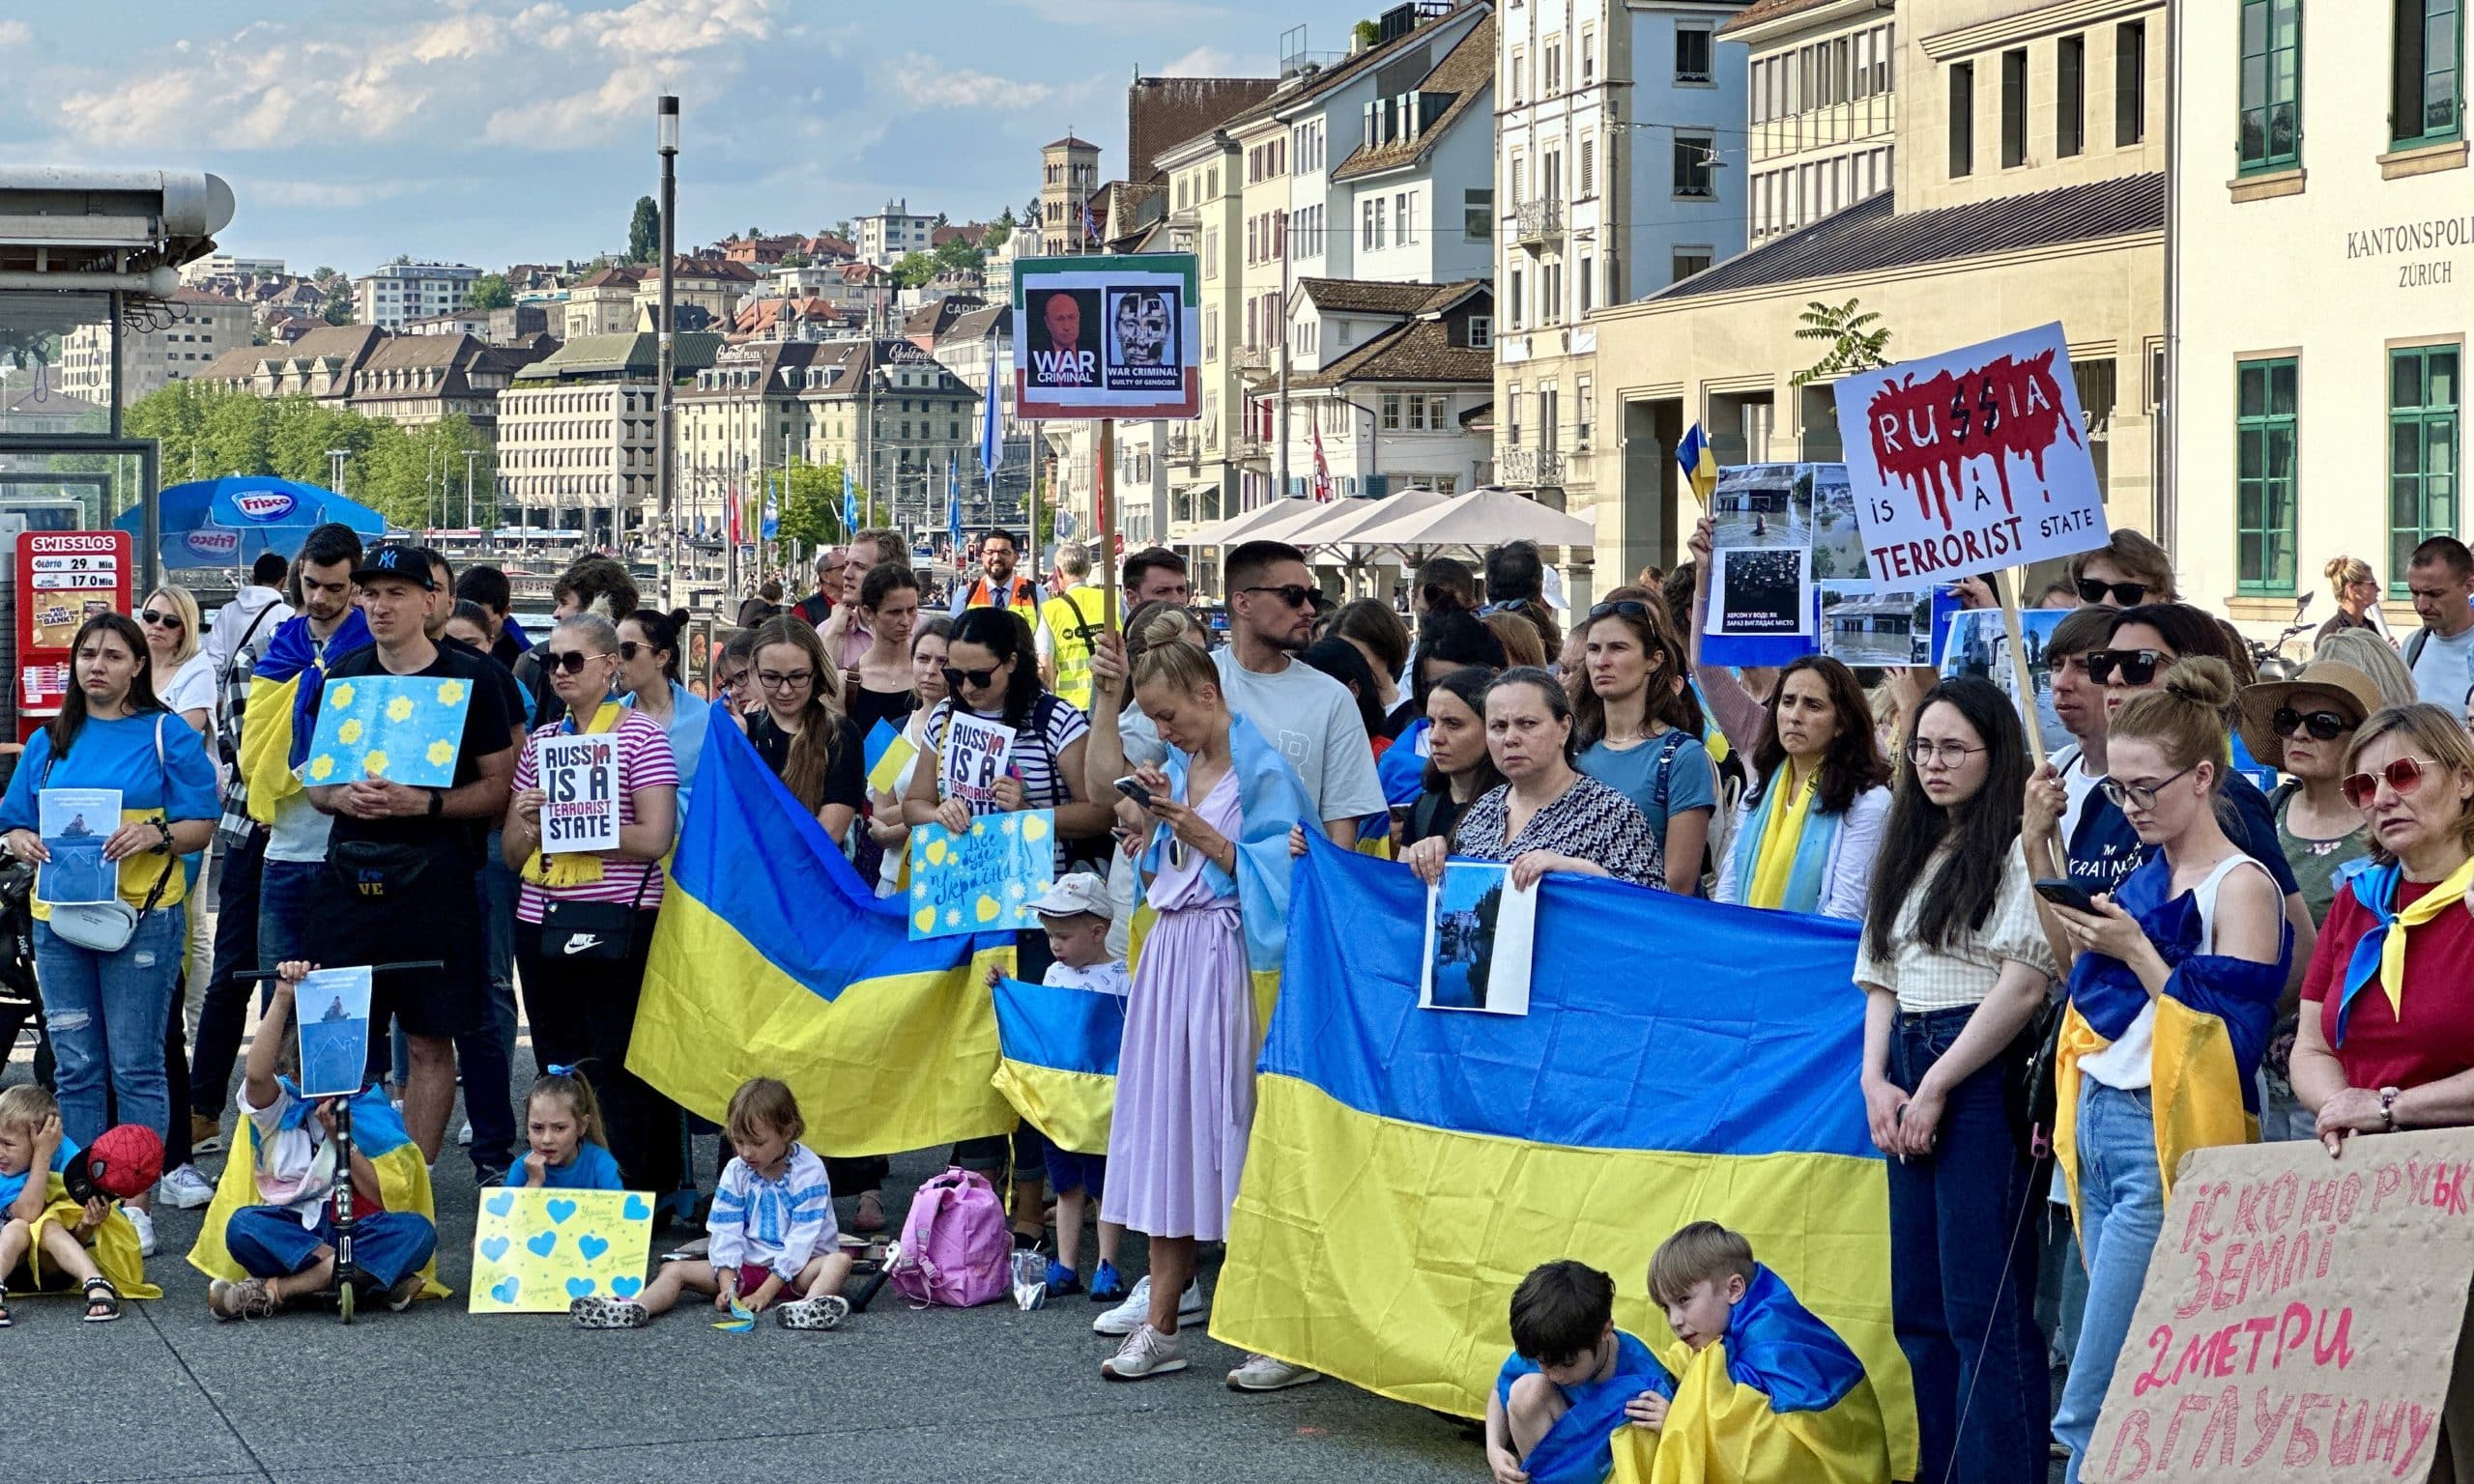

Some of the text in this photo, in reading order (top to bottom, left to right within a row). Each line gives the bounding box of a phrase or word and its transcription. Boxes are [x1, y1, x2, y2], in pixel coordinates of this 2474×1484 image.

[2399, 260, 2452, 288] ZÜRICH
[1032, 350, 1096, 373] WAR
[1108, 366, 1178, 377] WAR CRIMINAL
[1037, 372, 1093, 383] CRIMINAL
[1878, 373, 2052, 455] RUSSIA
[242, 497, 291, 511] Frisco
[1974, 485, 1991, 512] A
[33, 537, 115, 550] SWISSLOS
[1870, 507, 2093, 582] TERRORIST STATE
[952, 722, 1005, 756] RUSSIA
[545, 743, 611, 769] RUSSIA
[950, 744, 996, 787] IS A
[548, 766, 609, 803] IS A
[949, 778, 996, 801] TERRORIS
[548, 800, 612, 817] TERRORIST
[549, 814, 611, 840] STATE
[569, 933, 596, 946] NIKE
[2370, 1158, 2474, 1217] РУСЬК
